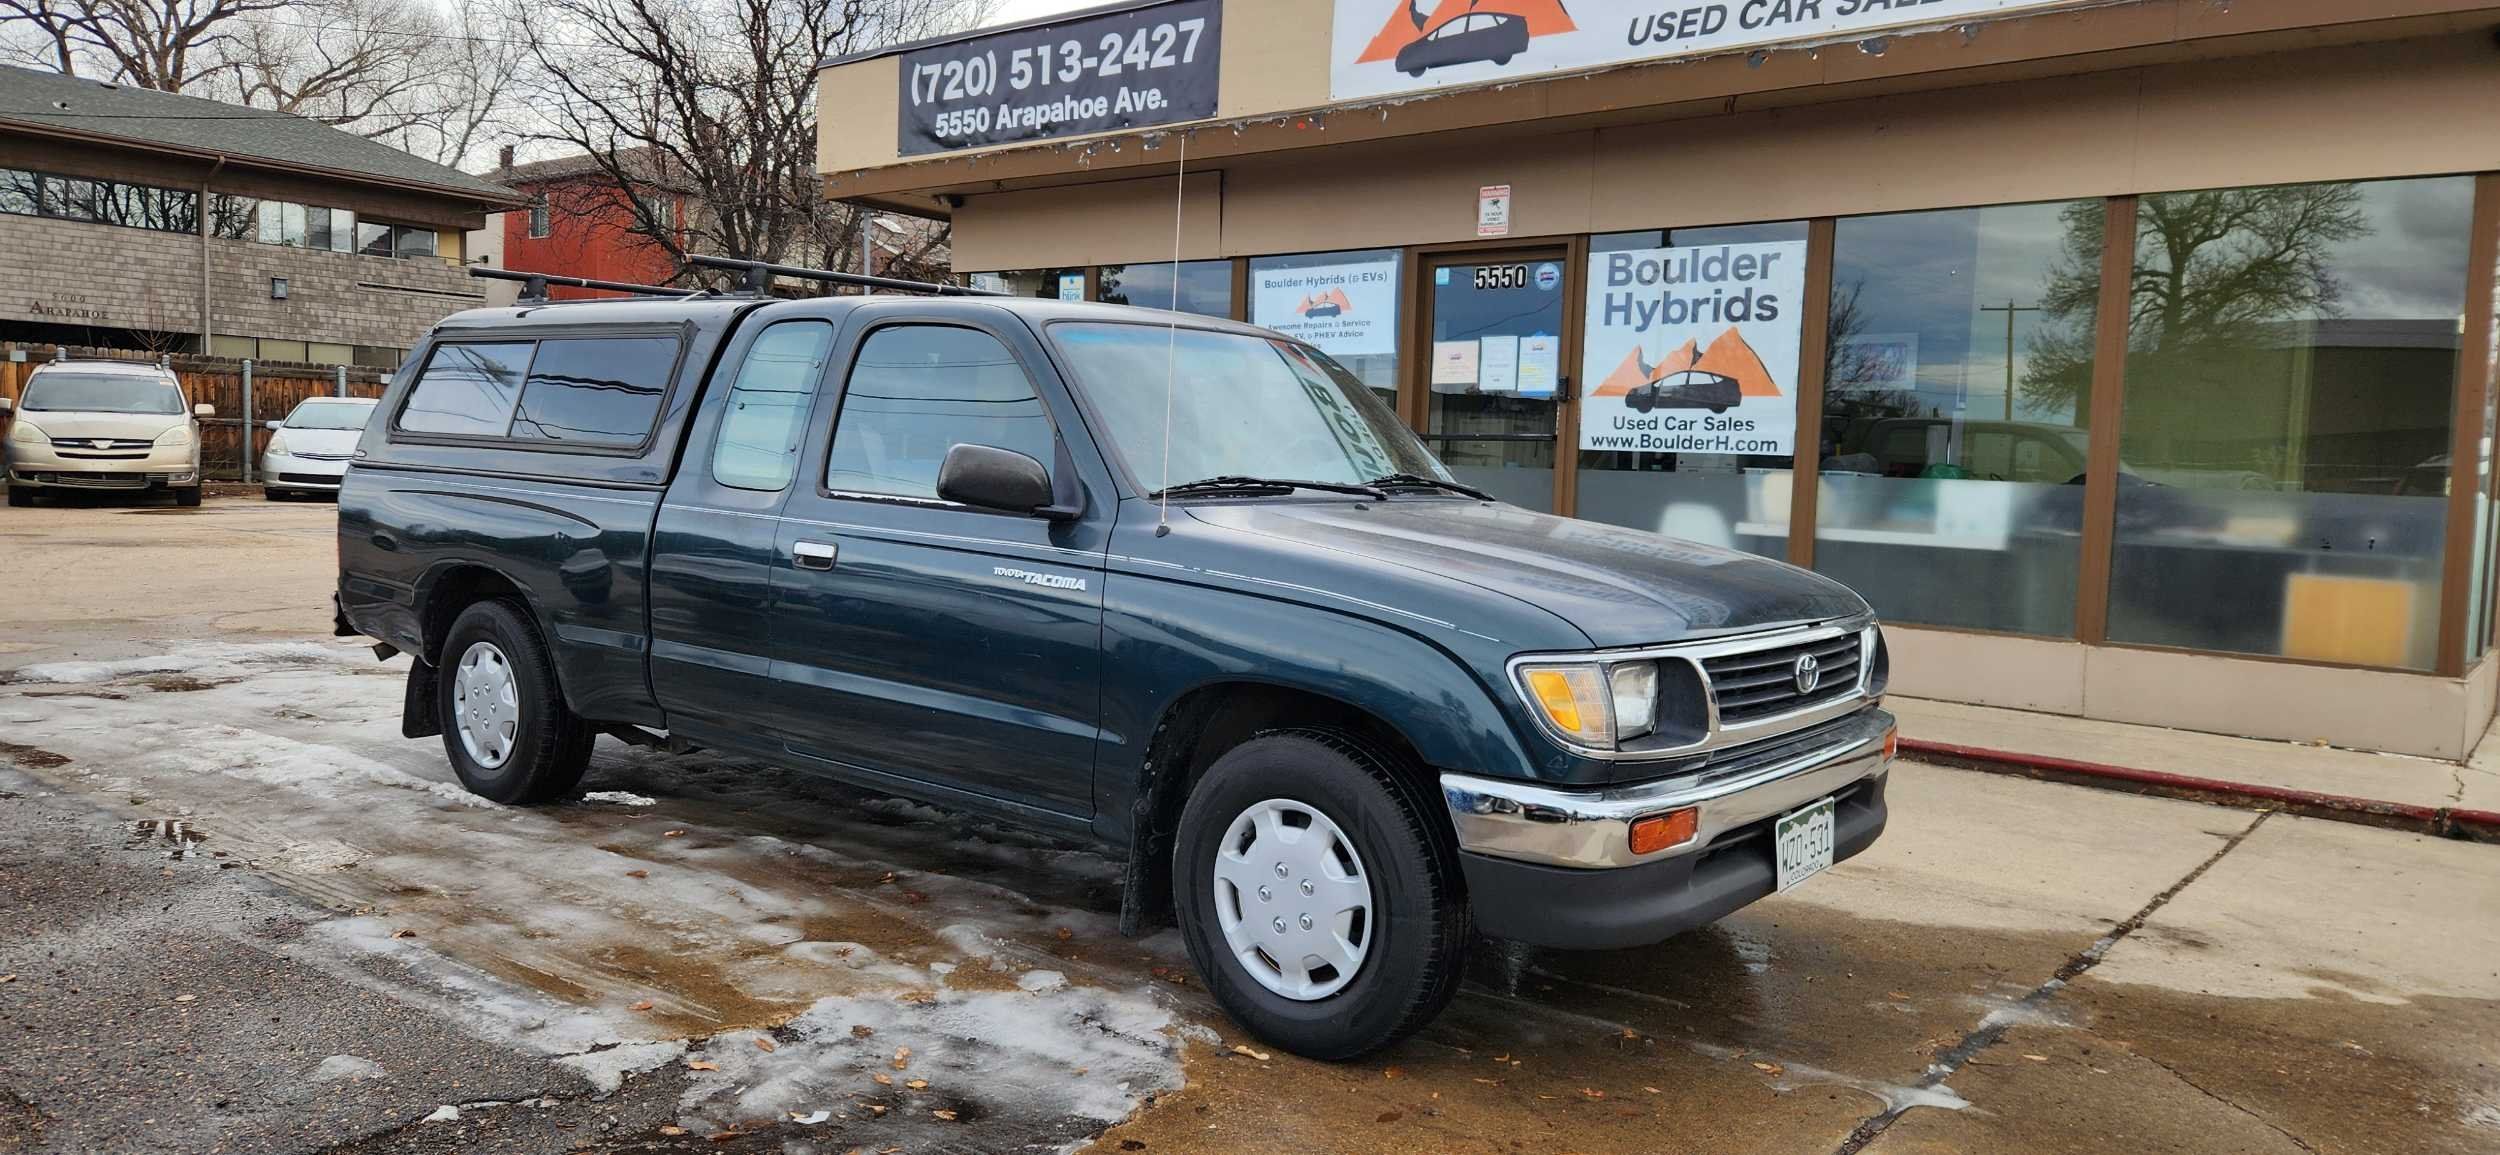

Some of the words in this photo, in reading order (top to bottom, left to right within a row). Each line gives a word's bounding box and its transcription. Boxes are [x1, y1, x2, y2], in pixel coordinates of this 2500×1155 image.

[1627, 0, 1727, 46] USED
[1739, 0, 1820, 30] CAR
[911, 50, 997, 106] (720)
[1009, 17, 1206, 90] 513-2427
[935, 106, 990, 138] 5550
[995, 95, 1108, 131] Arapahoe
[1113, 86, 1168, 114] Ave.
[1264, 277, 1303, 289] Boulder
[1306, 274, 1345, 288] Hybrids
[1362, 270, 1388, 284] EVs)
[1474, 264, 1528, 290] 5550
[1607, 246, 1782, 287] Boulder
[1603, 286, 1779, 333] Hybrids
[1303, 322, 1333, 330] Repairs
[1341, 319, 1372, 328] Service
[1613, 415, 1658, 431] Used
[1664, 416, 1697, 431] Car
[1703, 416, 1755, 432] Sales
[1591, 433, 1778, 453] www.BoulderH.com
[993, 567, 1024, 579] TOYOTA
[1024, 571, 1086, 591] TACOMA
